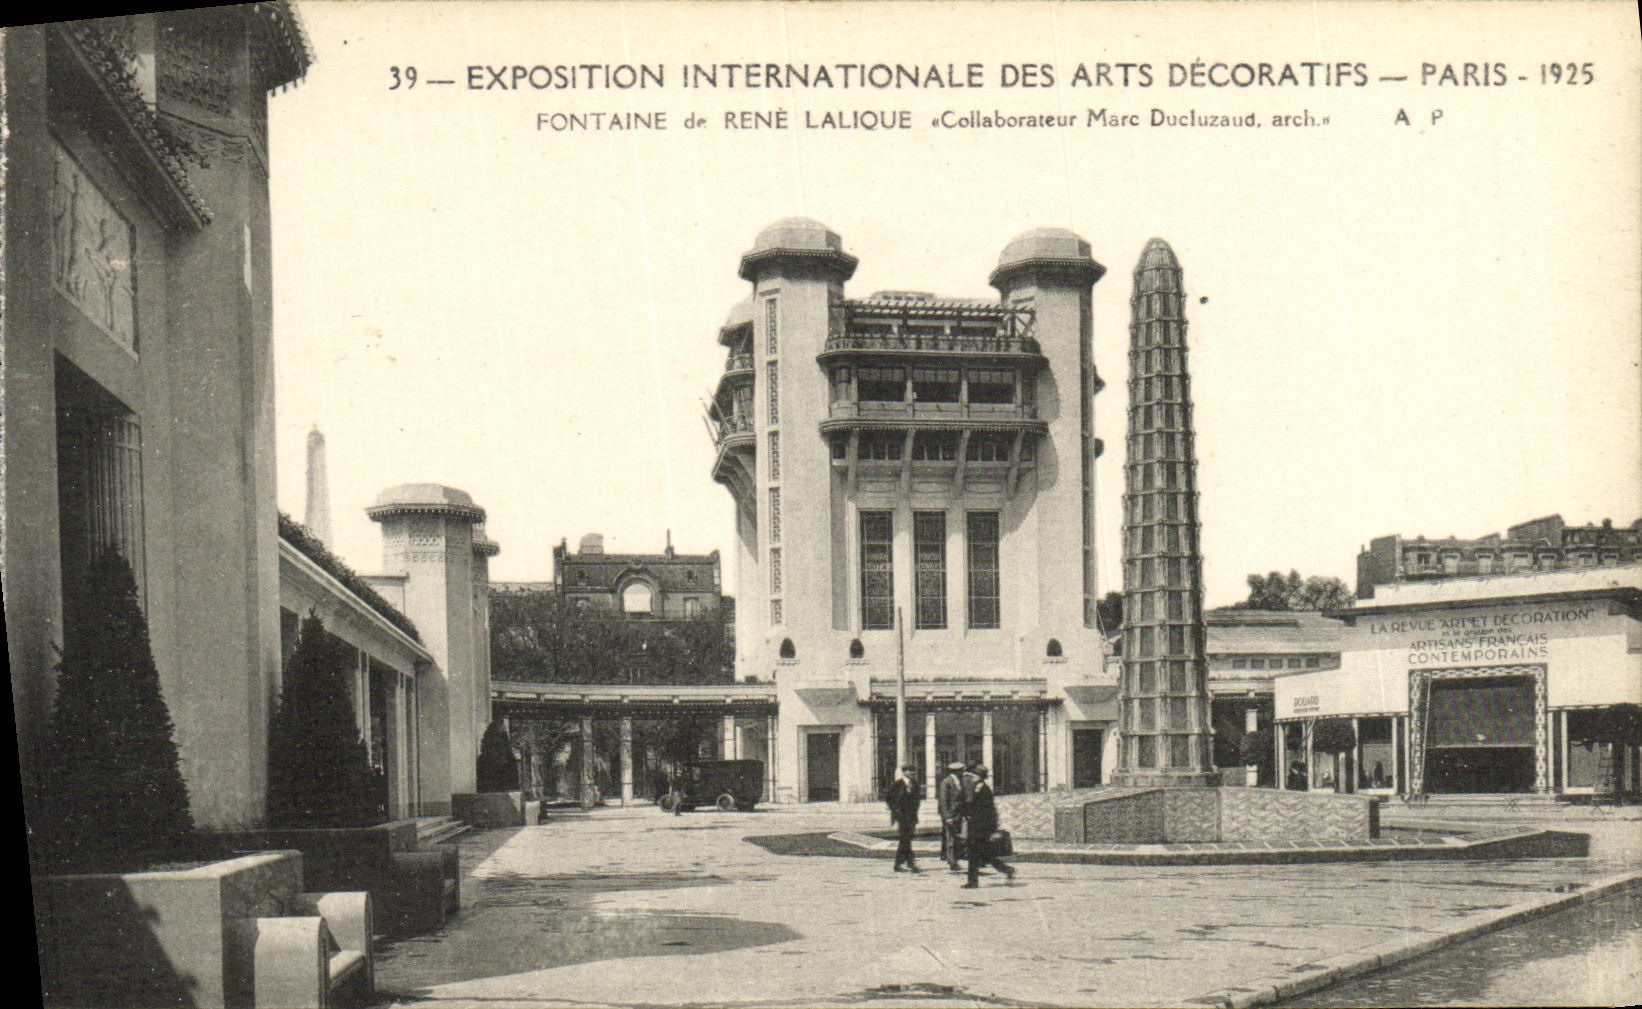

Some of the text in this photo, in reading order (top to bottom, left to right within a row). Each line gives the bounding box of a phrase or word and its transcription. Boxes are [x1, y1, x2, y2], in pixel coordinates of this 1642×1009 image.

[1371, 623, 1387, 635] LA
[1392, 619, 1436, 633] REVUE
[1472, 615, 1487, 627] ET
[1497, 624, 1512, 634] des
[1410, 638, 1473, 651] ARTISANS
[1408, 646, 1549, 665] CONTEMPORAINS
